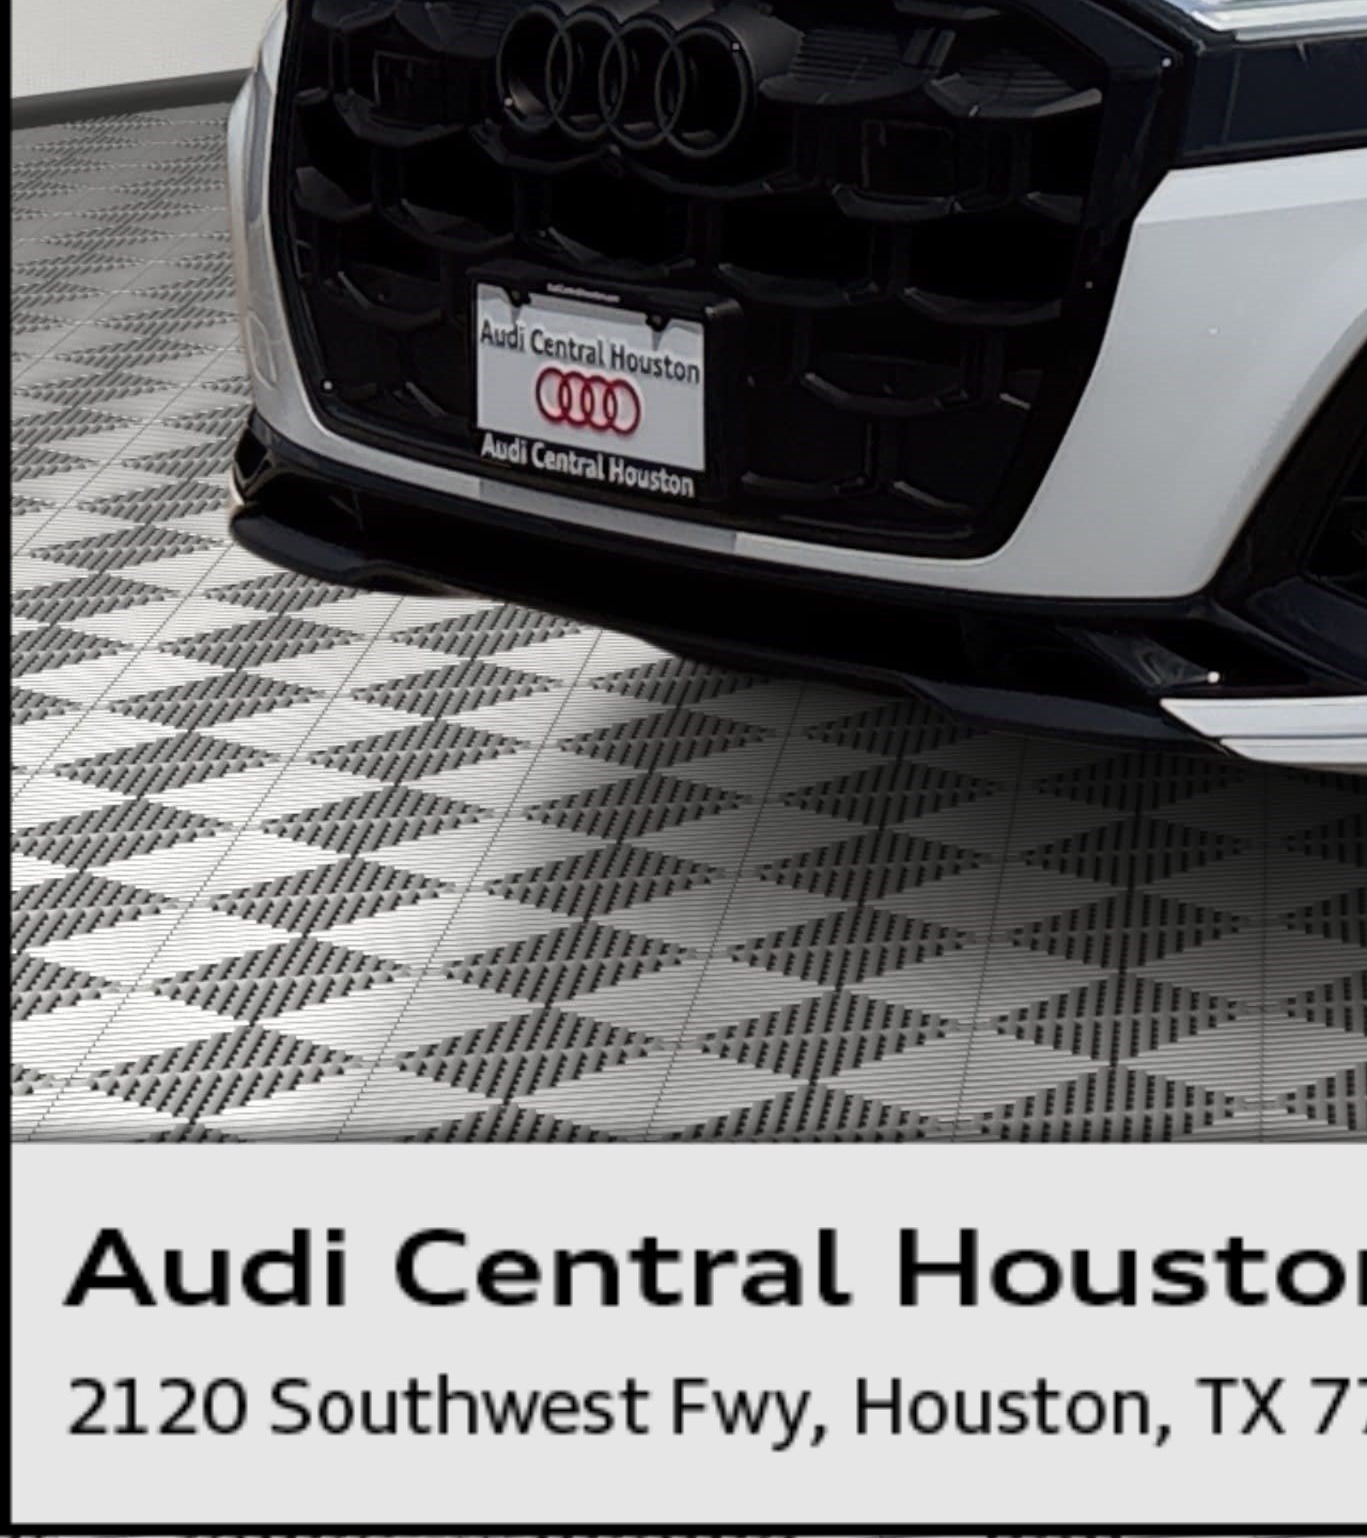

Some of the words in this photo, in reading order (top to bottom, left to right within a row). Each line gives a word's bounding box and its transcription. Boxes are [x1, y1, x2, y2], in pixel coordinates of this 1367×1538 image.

[480, 318, 526, 353] Audi
[530, 328, 605, 367] Central
[611, 344, 700, 385] Houston
[481, 432, 528, 465] Audi
[531, 443, 605, 481] Central
[609, 458, 696, 498] Houston
